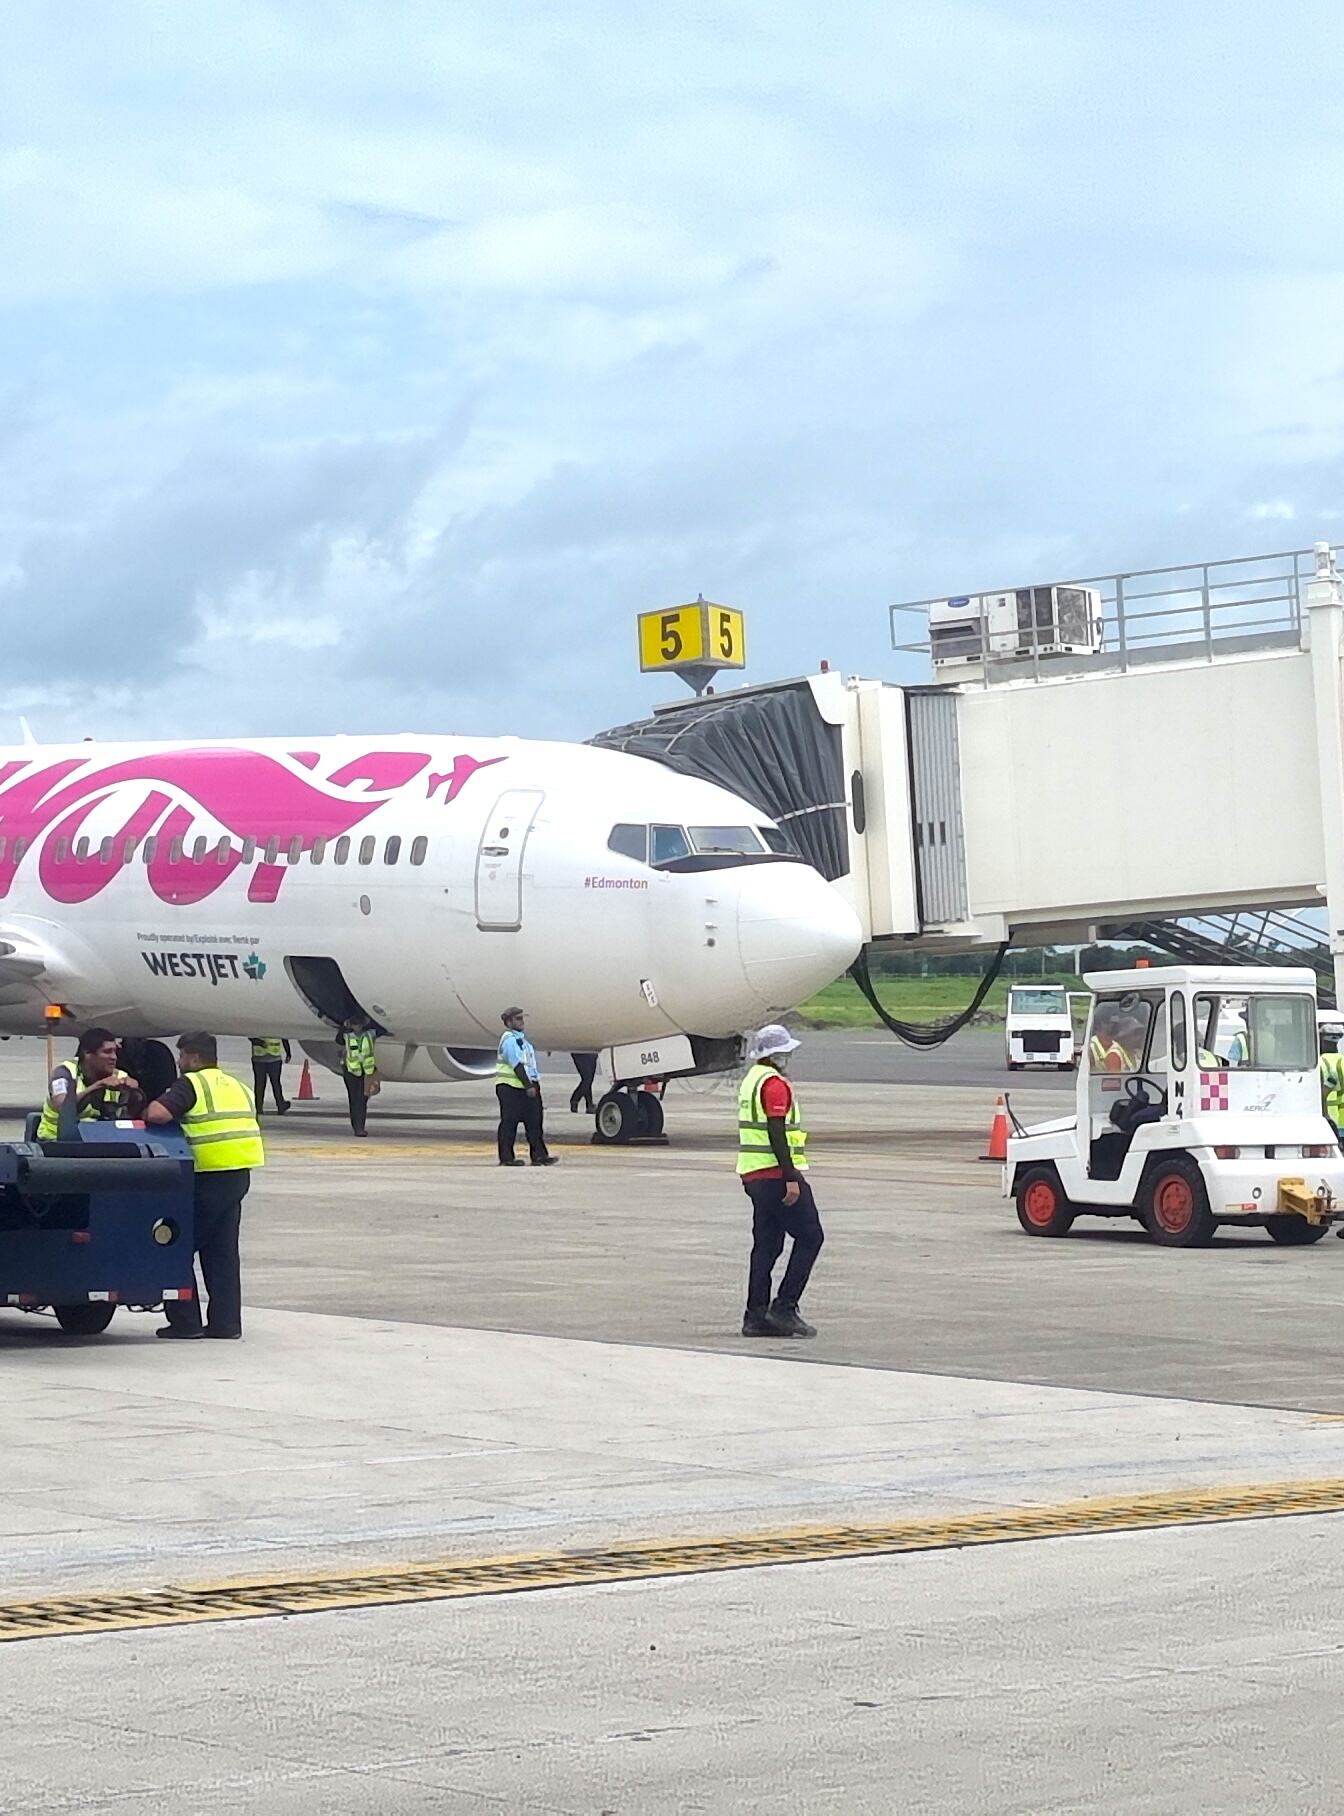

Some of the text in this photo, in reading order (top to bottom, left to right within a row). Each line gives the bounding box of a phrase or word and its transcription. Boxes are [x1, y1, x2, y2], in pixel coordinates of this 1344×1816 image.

[661, 614, 682, 660] 5
[719, 612, 732, 658] 5
[584, 876, 648, 889] #Edmonton
[141, 951, 239, 986] WESTJET
[641, 1051, 659, 1065] 848
